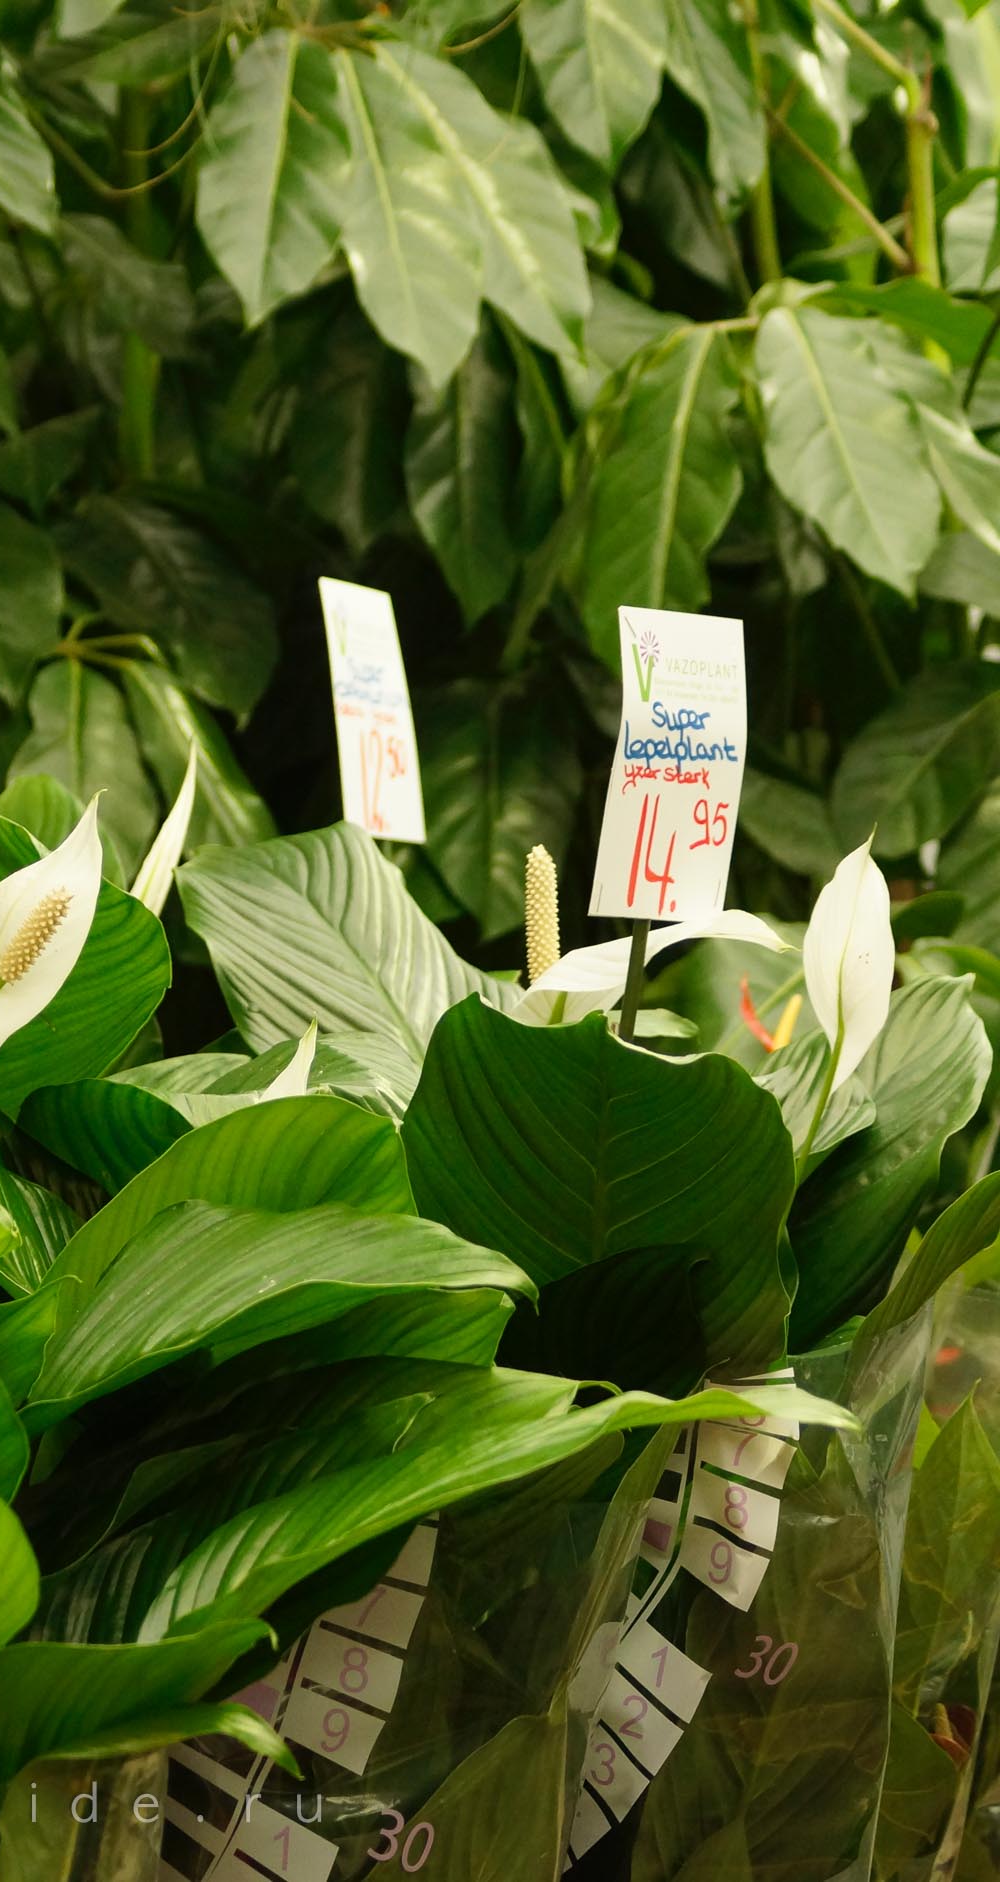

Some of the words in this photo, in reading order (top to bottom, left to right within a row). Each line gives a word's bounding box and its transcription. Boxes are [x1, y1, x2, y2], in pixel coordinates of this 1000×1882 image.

[664, 656, 738, 680] VAZOPLANT
[651, 701, 711, 742] Super
[724, 1486, 749, 1529] 8
[708, 1541, 735, 1585] 9
[339, 1647, 369, 1694] 8
[650, 1646, 670, 1688] 1
[734, 1635, 799, 1686] 30
[320, 1708, 351, 1754] 9
[619, 1695, 649, 1740] 2
[590, 1743, 616, 1786] 3
[272, 1825, 292, 1872] 1
[367, 1809, 435, 1874] 30
